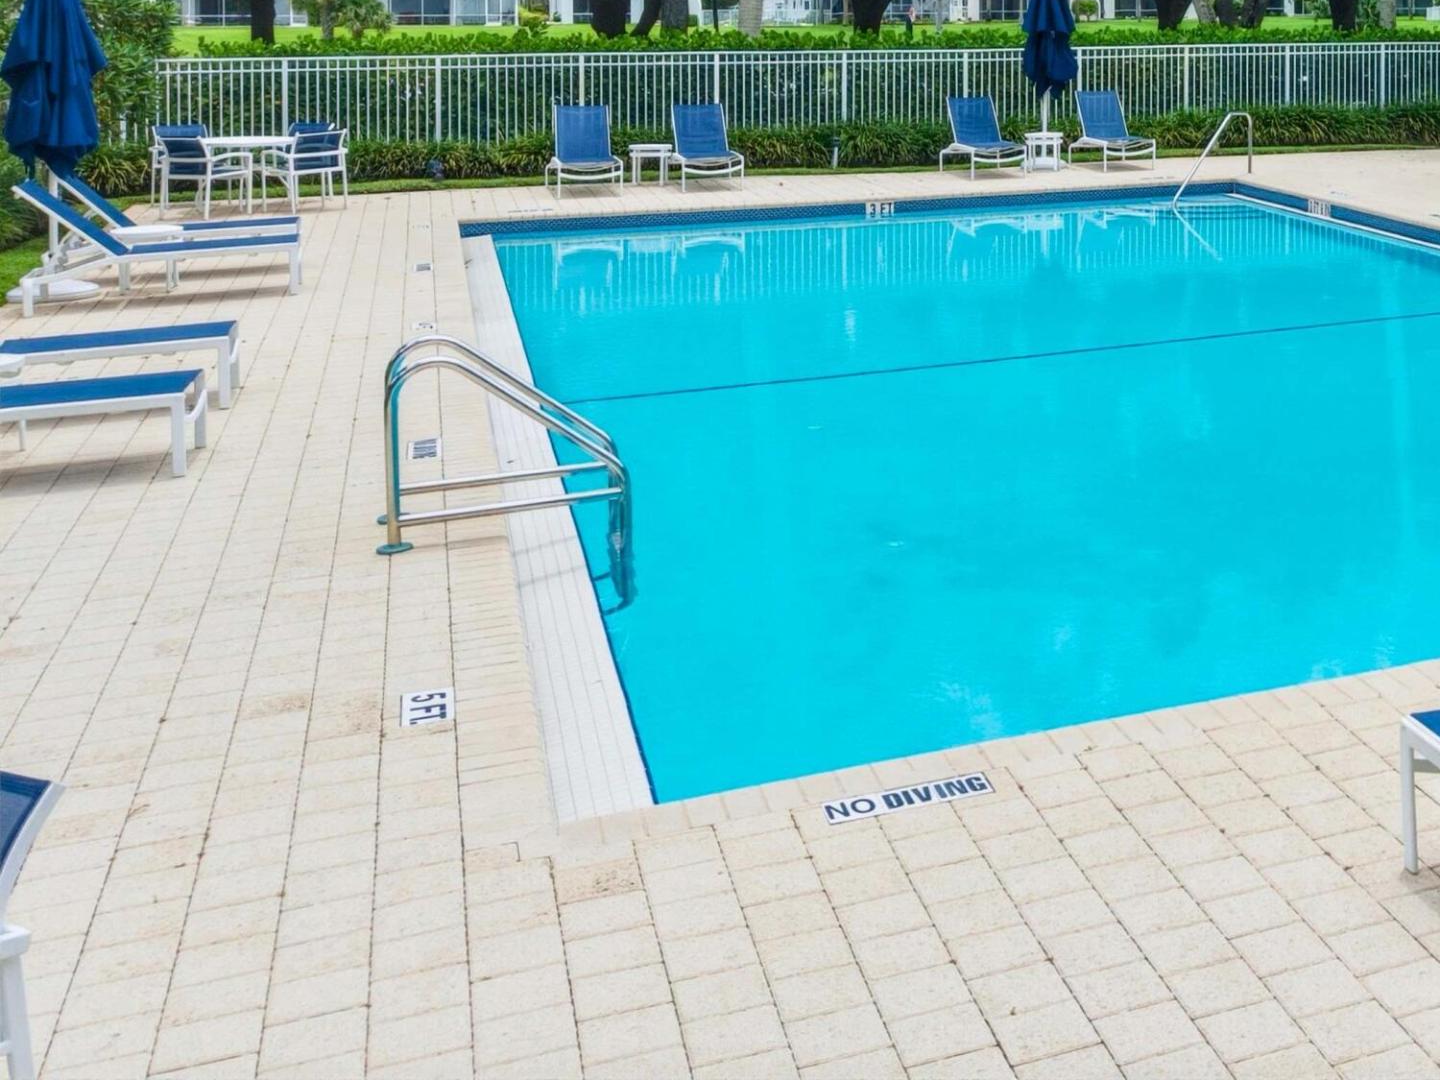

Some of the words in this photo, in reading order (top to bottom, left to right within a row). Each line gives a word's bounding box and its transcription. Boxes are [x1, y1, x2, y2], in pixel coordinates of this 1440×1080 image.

[411, 692, 446, 702] 5
[824, 798, 876, 820] NO
[881, 776, 988, 809] DIVING
